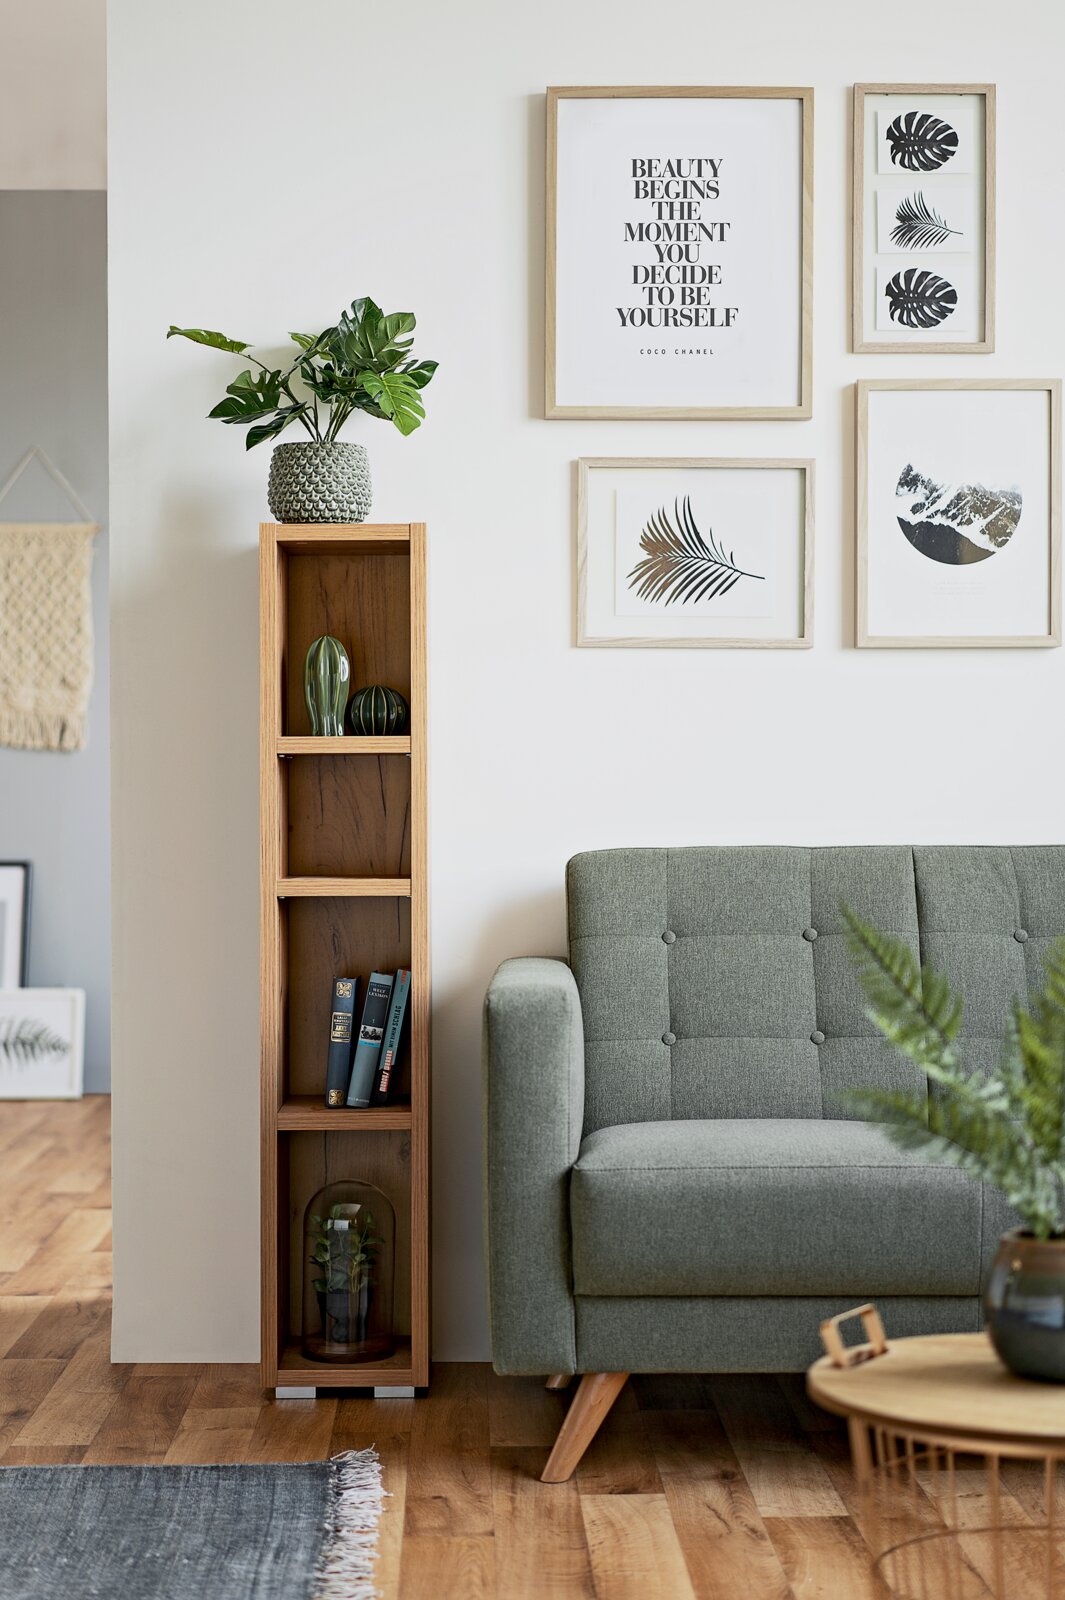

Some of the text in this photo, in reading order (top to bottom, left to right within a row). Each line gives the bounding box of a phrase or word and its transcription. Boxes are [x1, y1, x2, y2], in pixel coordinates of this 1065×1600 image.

[631, 158, 723, 178] BEAUTY
[634, 179, 720, 199] BEGINS
[652, 201, 701, 221] THE
[624, 222, 730, 242] MOMENT
[654, 243, 700, 263] YOU
[632, 265, 722, 284] DECIDE
[642, 286, 711, 306] TO BE
[616, 307, 738, 328] YOURSELF
[392, 1005, 402, 1027] SCHLAG
